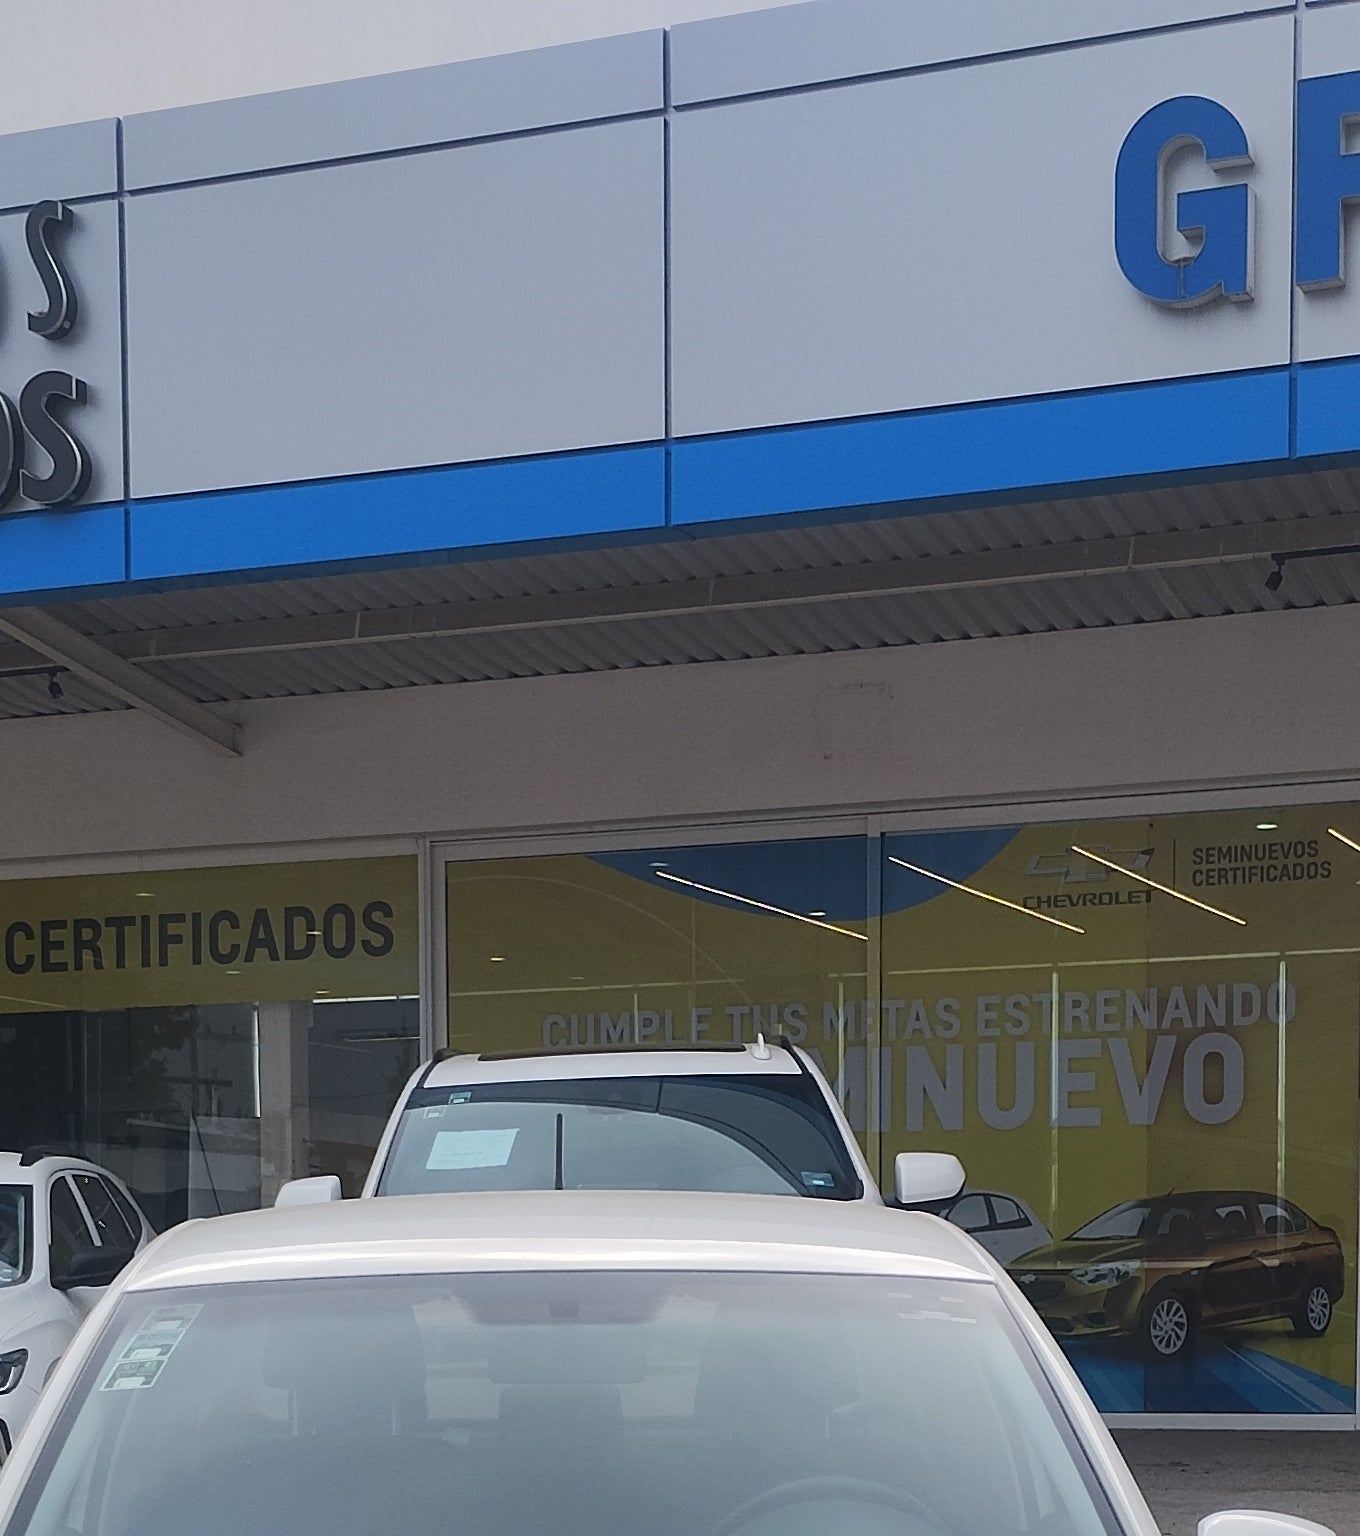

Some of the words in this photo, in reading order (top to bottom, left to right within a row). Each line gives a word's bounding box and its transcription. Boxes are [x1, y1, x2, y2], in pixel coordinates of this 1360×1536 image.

[1192, 839, 1319, 865] SEMINUEVOS
[1192, 861, 1333, 887] CERTIFICADOS
[1022, 890, 1153, 909] CHEVROLET
[4, 901, 395, 975] CERTIFICADOS
[725, 1003, 807, 1043] TUS
[977, 980, 1297, 1038] ESTRENANDO
